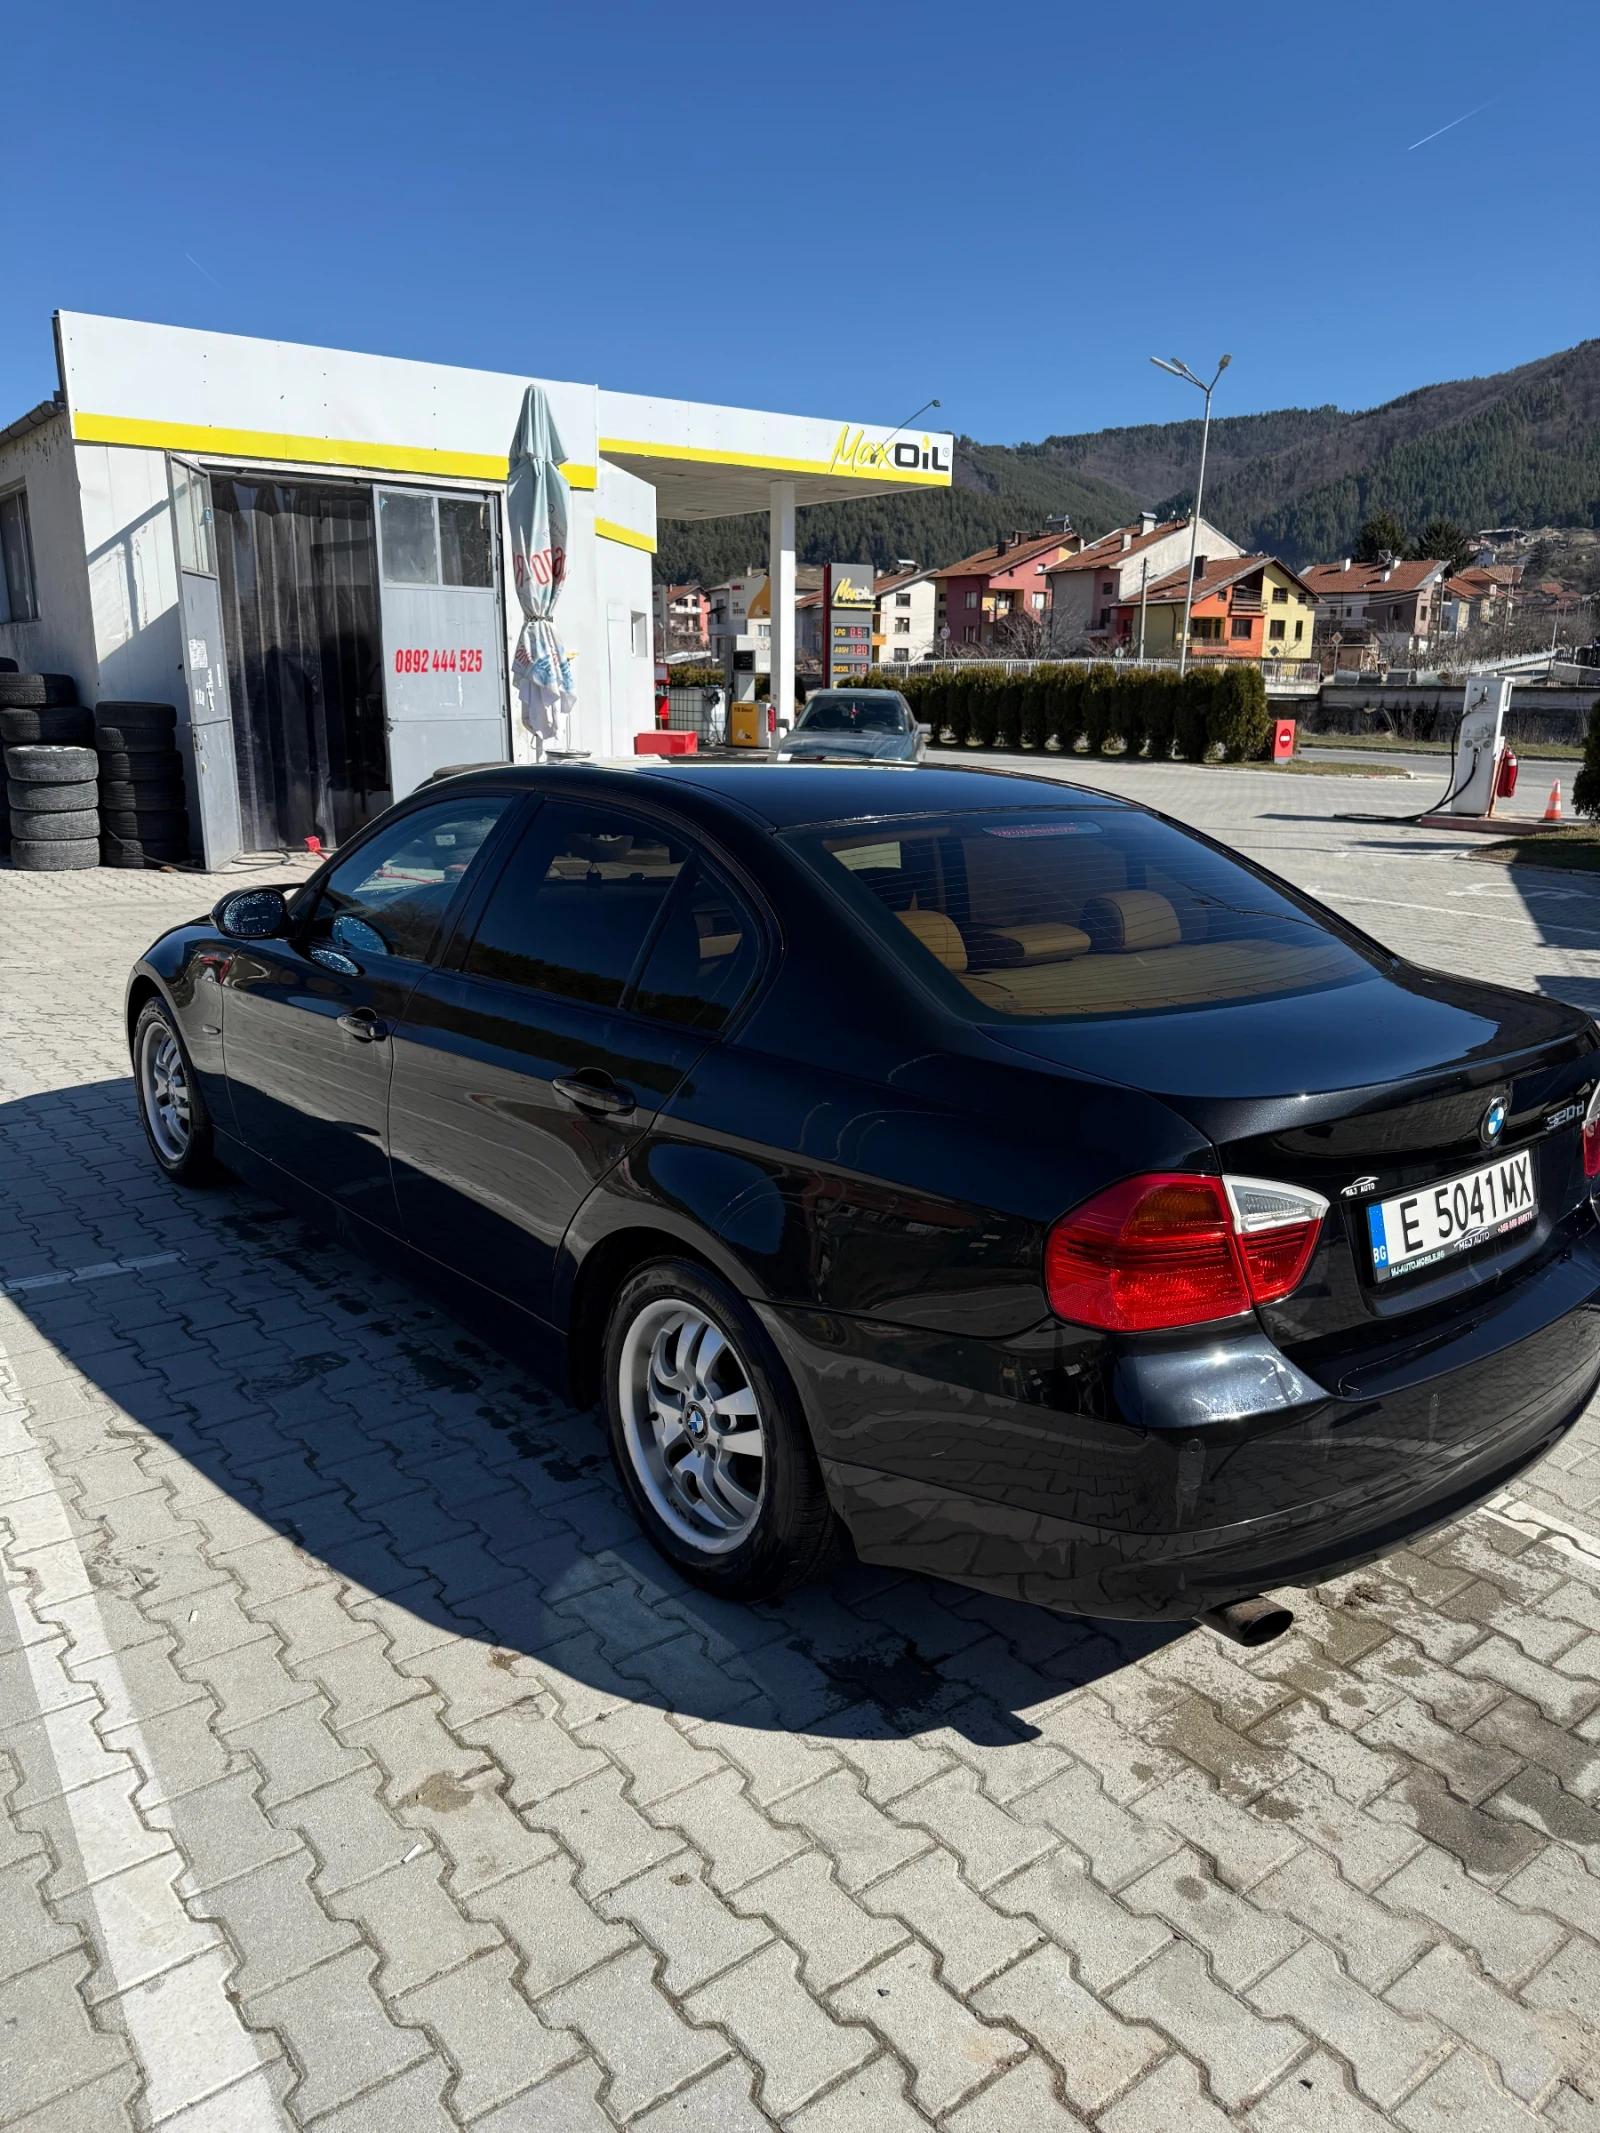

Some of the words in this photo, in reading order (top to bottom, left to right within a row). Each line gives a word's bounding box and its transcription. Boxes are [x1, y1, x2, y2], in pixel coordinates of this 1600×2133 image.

[834, 629, 846, 637] LPG
[395, 649, 429, 673] 0892
[432, 649, 456, 672] 444
[460, 649, 482, 672] 525
[832, 665, 849, 673] DIESEL
[1360, 1182, 1376, 1193] AUTO
[1399, 1198, 1424, 1254] E
[1435, 1170, 1497, 1238] 5041
[1500, 1156, 1532, 1213] MX
[1474, 1230, 1490, 1246] AUTO
[1372, 1245, 1387, 1264] BG
